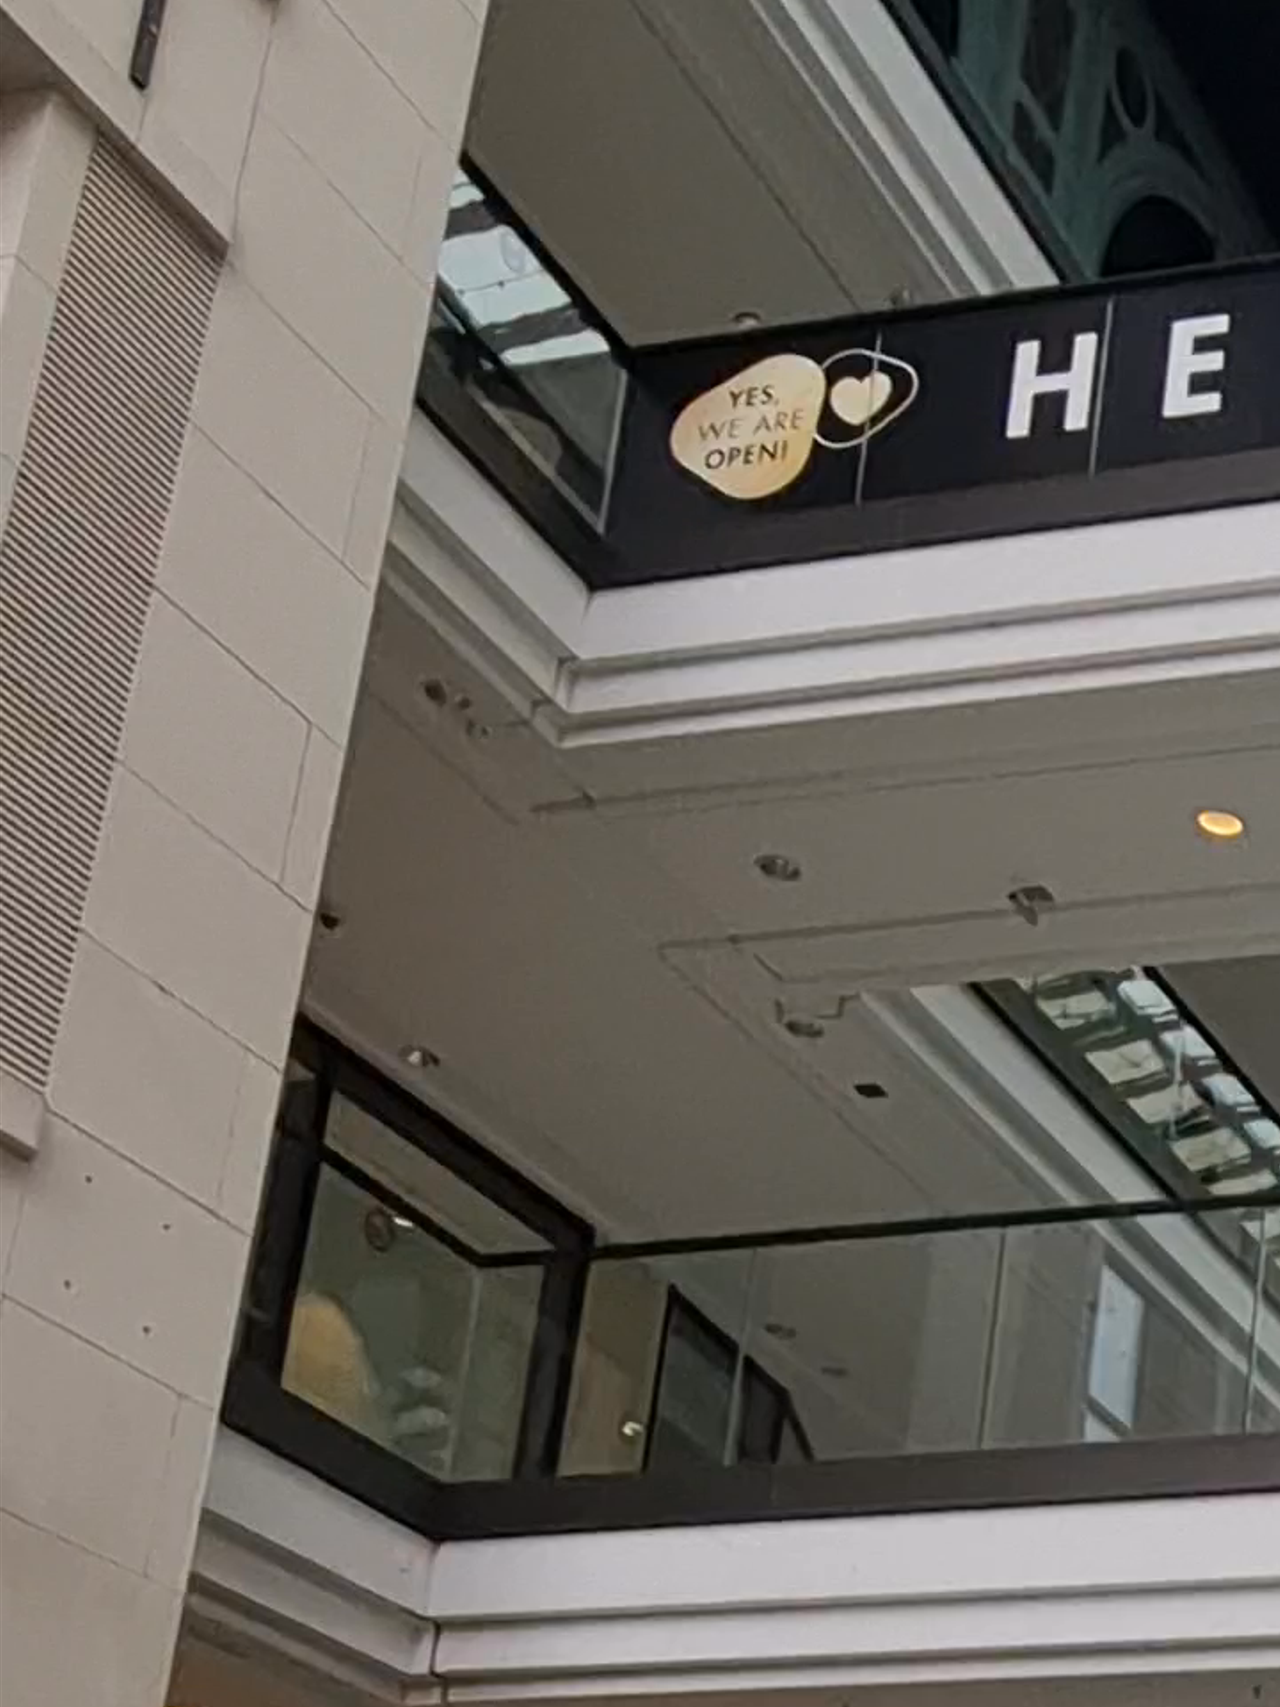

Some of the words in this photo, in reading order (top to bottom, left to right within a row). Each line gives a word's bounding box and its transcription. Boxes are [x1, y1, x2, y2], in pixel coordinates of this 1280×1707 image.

[729, 385, 780, 409] YES,
[698, 418, 743, 442] WE
[753, 409, 804, 435] ARE
